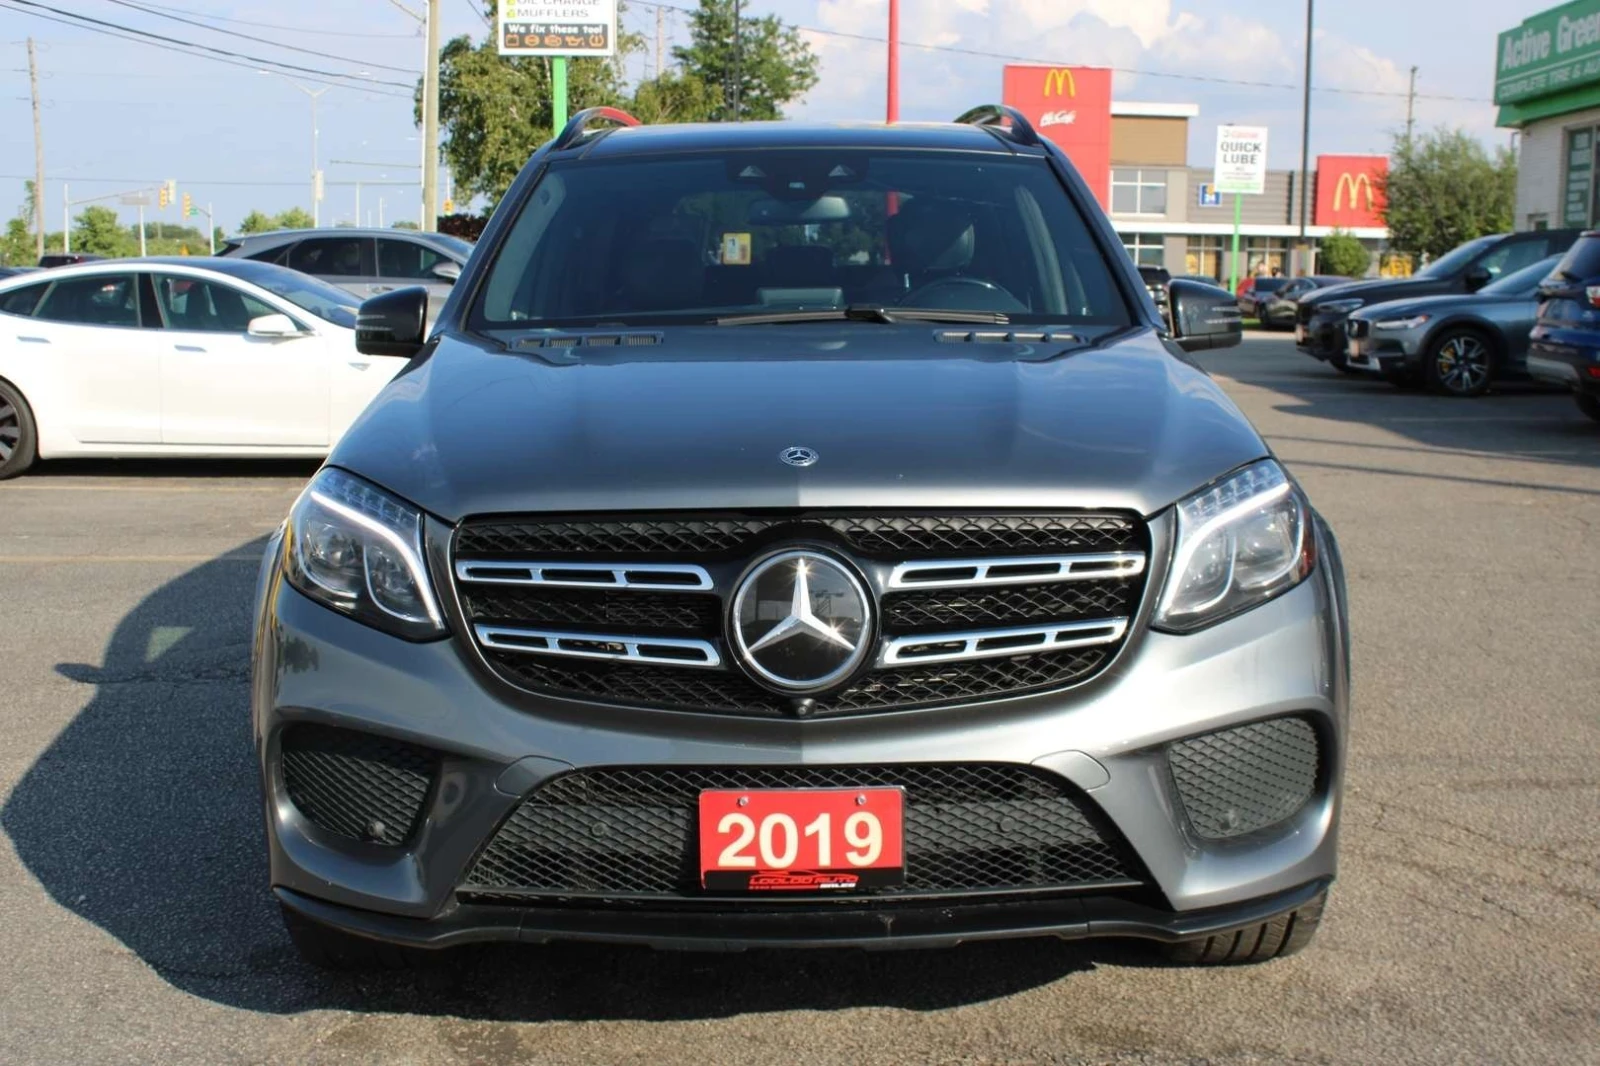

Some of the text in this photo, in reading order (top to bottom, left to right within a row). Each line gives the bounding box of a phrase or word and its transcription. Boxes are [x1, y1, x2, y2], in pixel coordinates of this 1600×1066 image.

[517, 8, 590, 17] MUFFLERS
[508, 23, 526, 34] We
[530, 23, 546, 34] fix
[549, 23, 579, 34] these
[1501, 28, 1551, 71] Active
[1220, 141, 1262, 152] QUICK
[1222, 153, 1259, 165] LUBE
[717, 811, 883, 868] 2019
